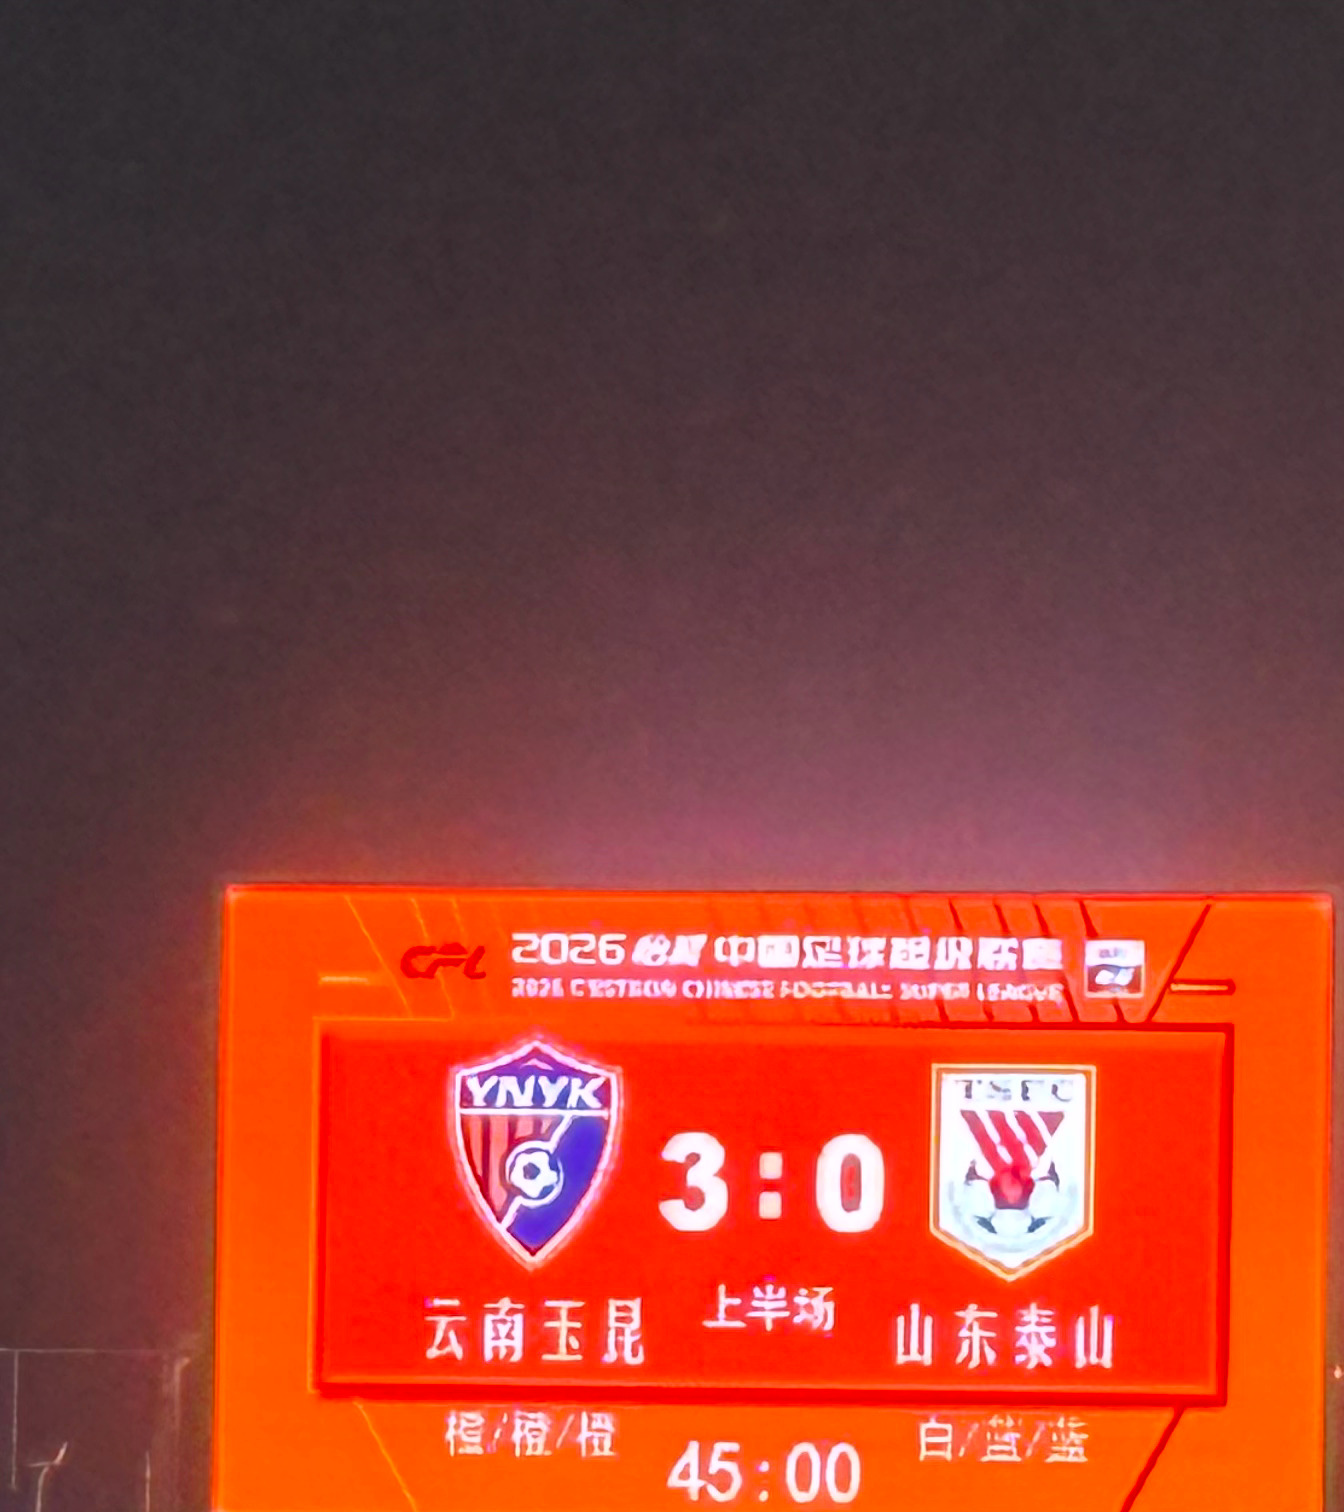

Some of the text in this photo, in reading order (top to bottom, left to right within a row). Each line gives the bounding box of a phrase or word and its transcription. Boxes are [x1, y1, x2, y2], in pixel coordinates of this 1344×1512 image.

[511, 932, 627, 966] 2026
[465, 1073, 605, 1109] YNYK
[424, 1297, 645, 1365] 云南玉昆
[703, 1283, 835, 1331] 上半场
[895, 1303, 1115, 1370] 山东泰山
[666, 1440, 861, 1504] 45:00
